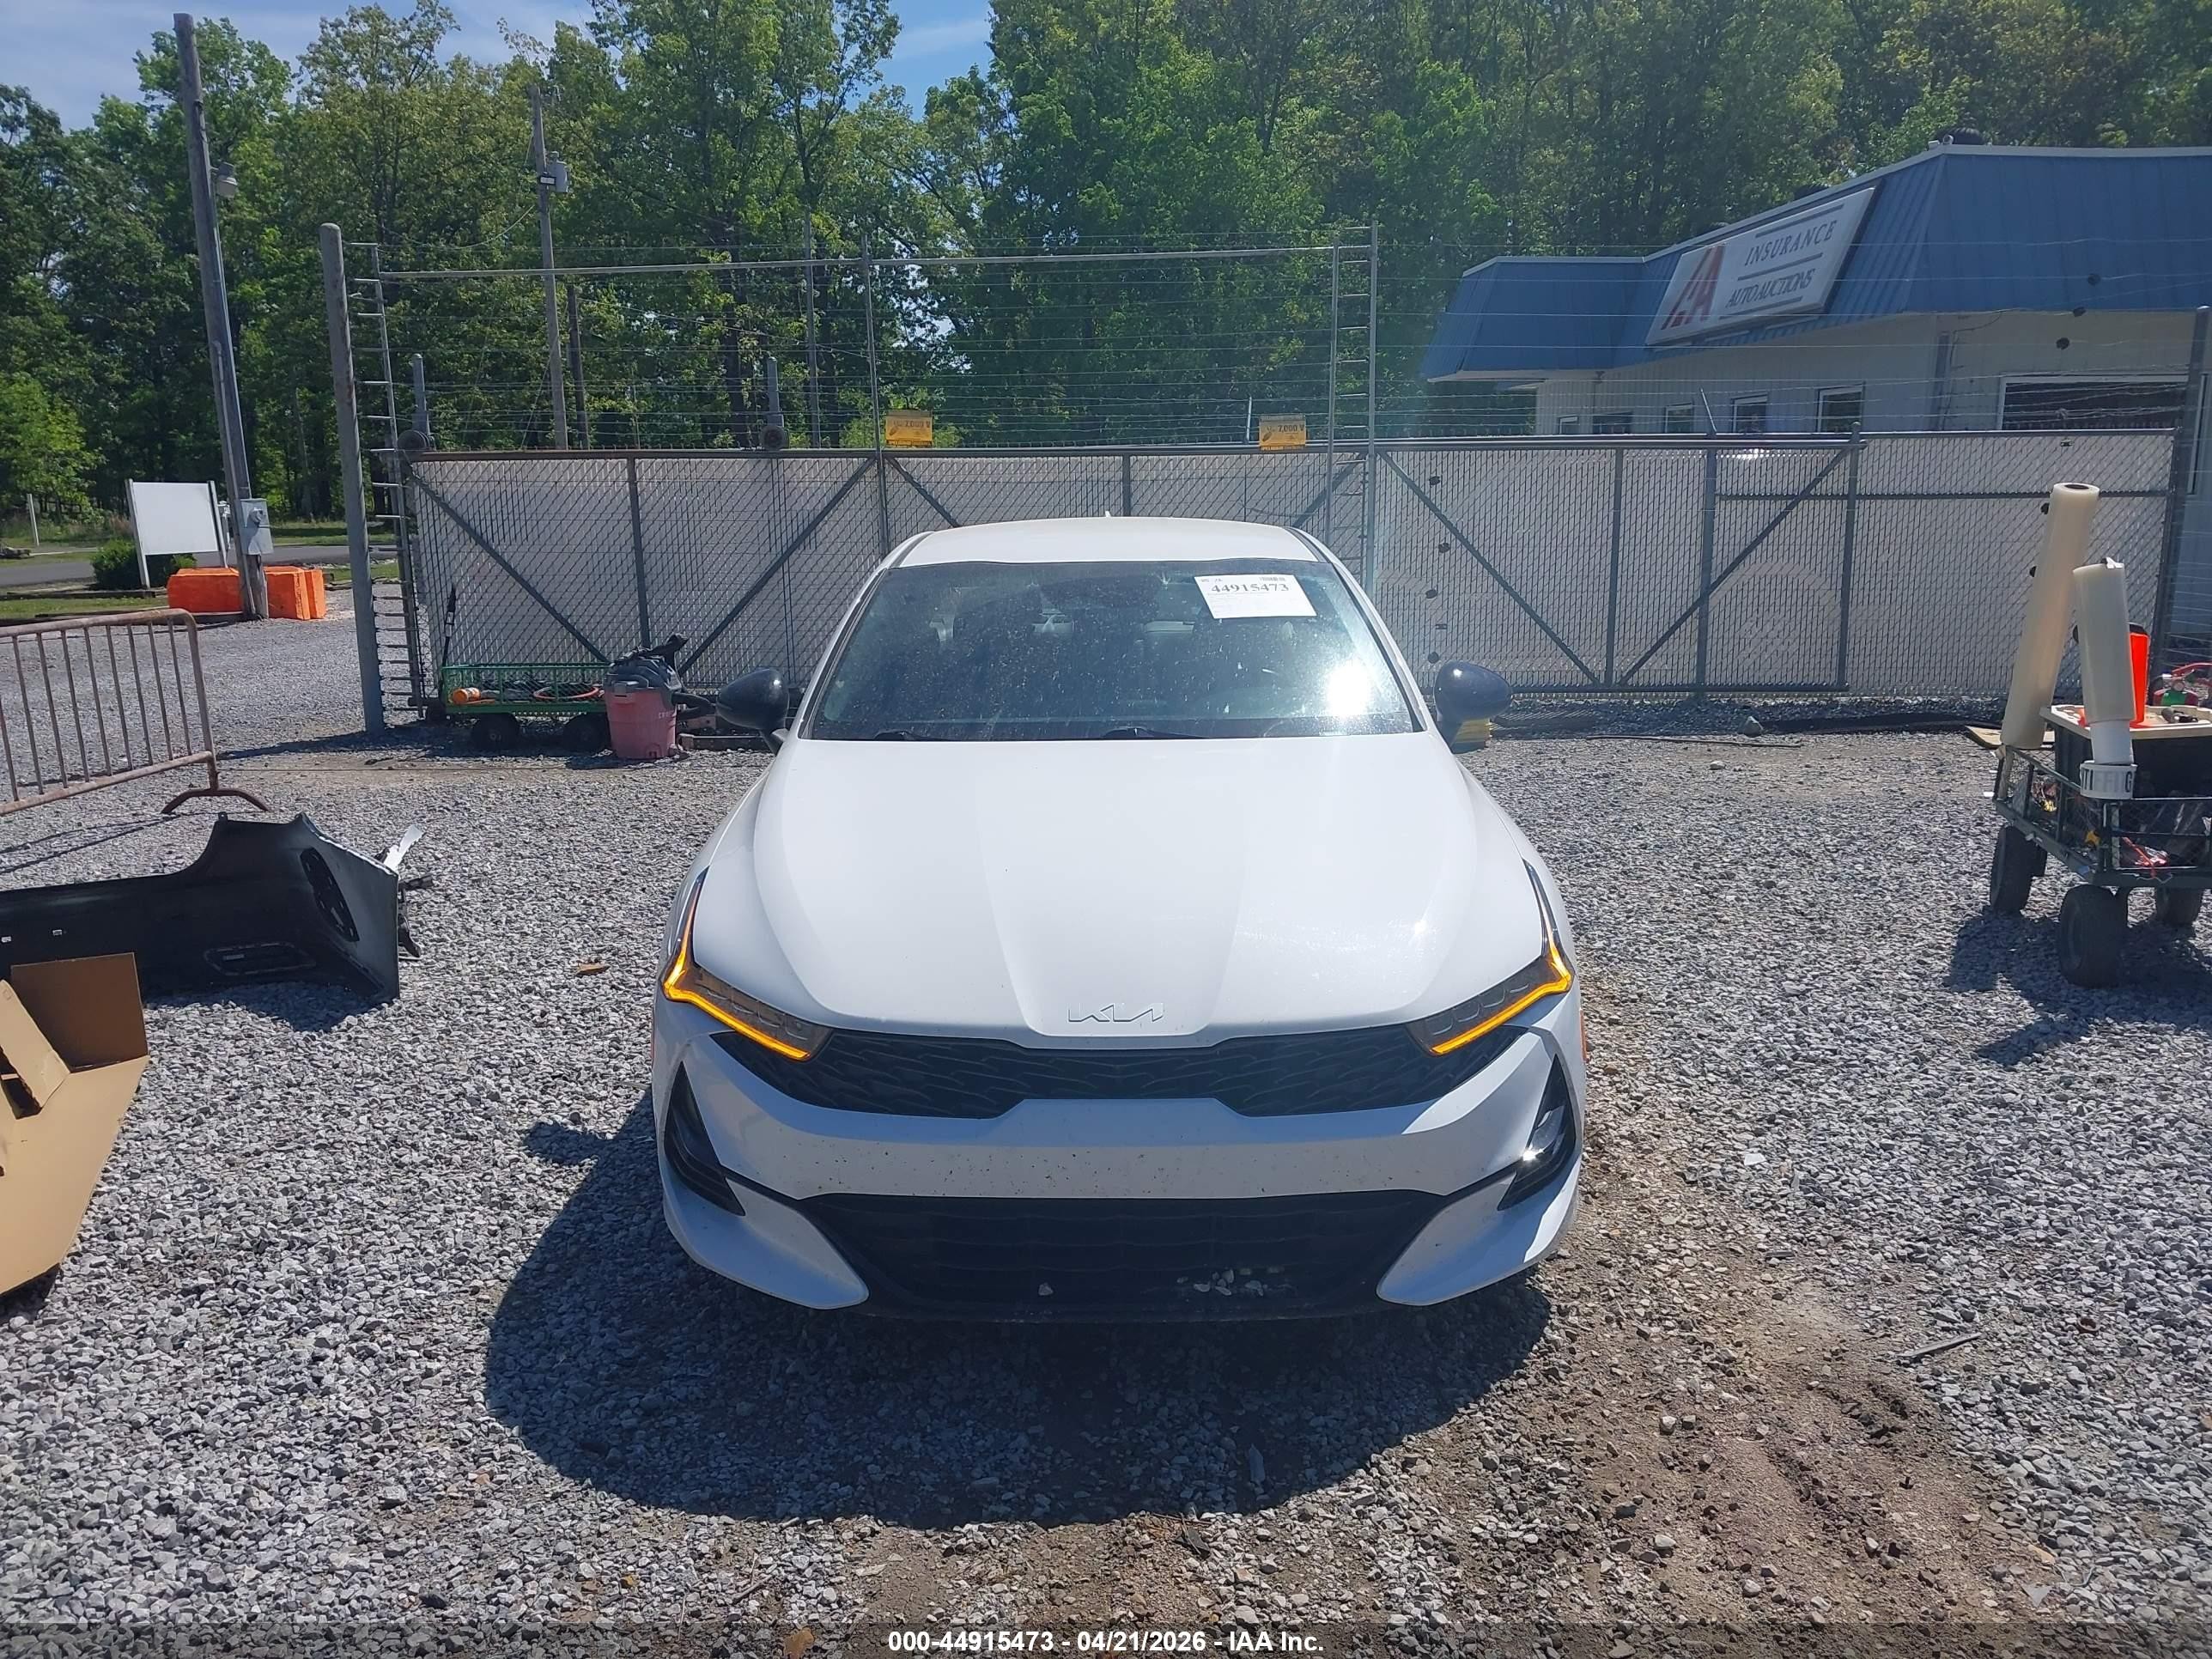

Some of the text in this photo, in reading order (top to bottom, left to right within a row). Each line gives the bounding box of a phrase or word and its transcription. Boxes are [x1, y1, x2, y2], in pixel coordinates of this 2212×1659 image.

[1745, 220, 1837, 266] INSURANCE
[1278, 424, 1298, 434] 7,000
[1211, 583, 1289, 592] 44915473
